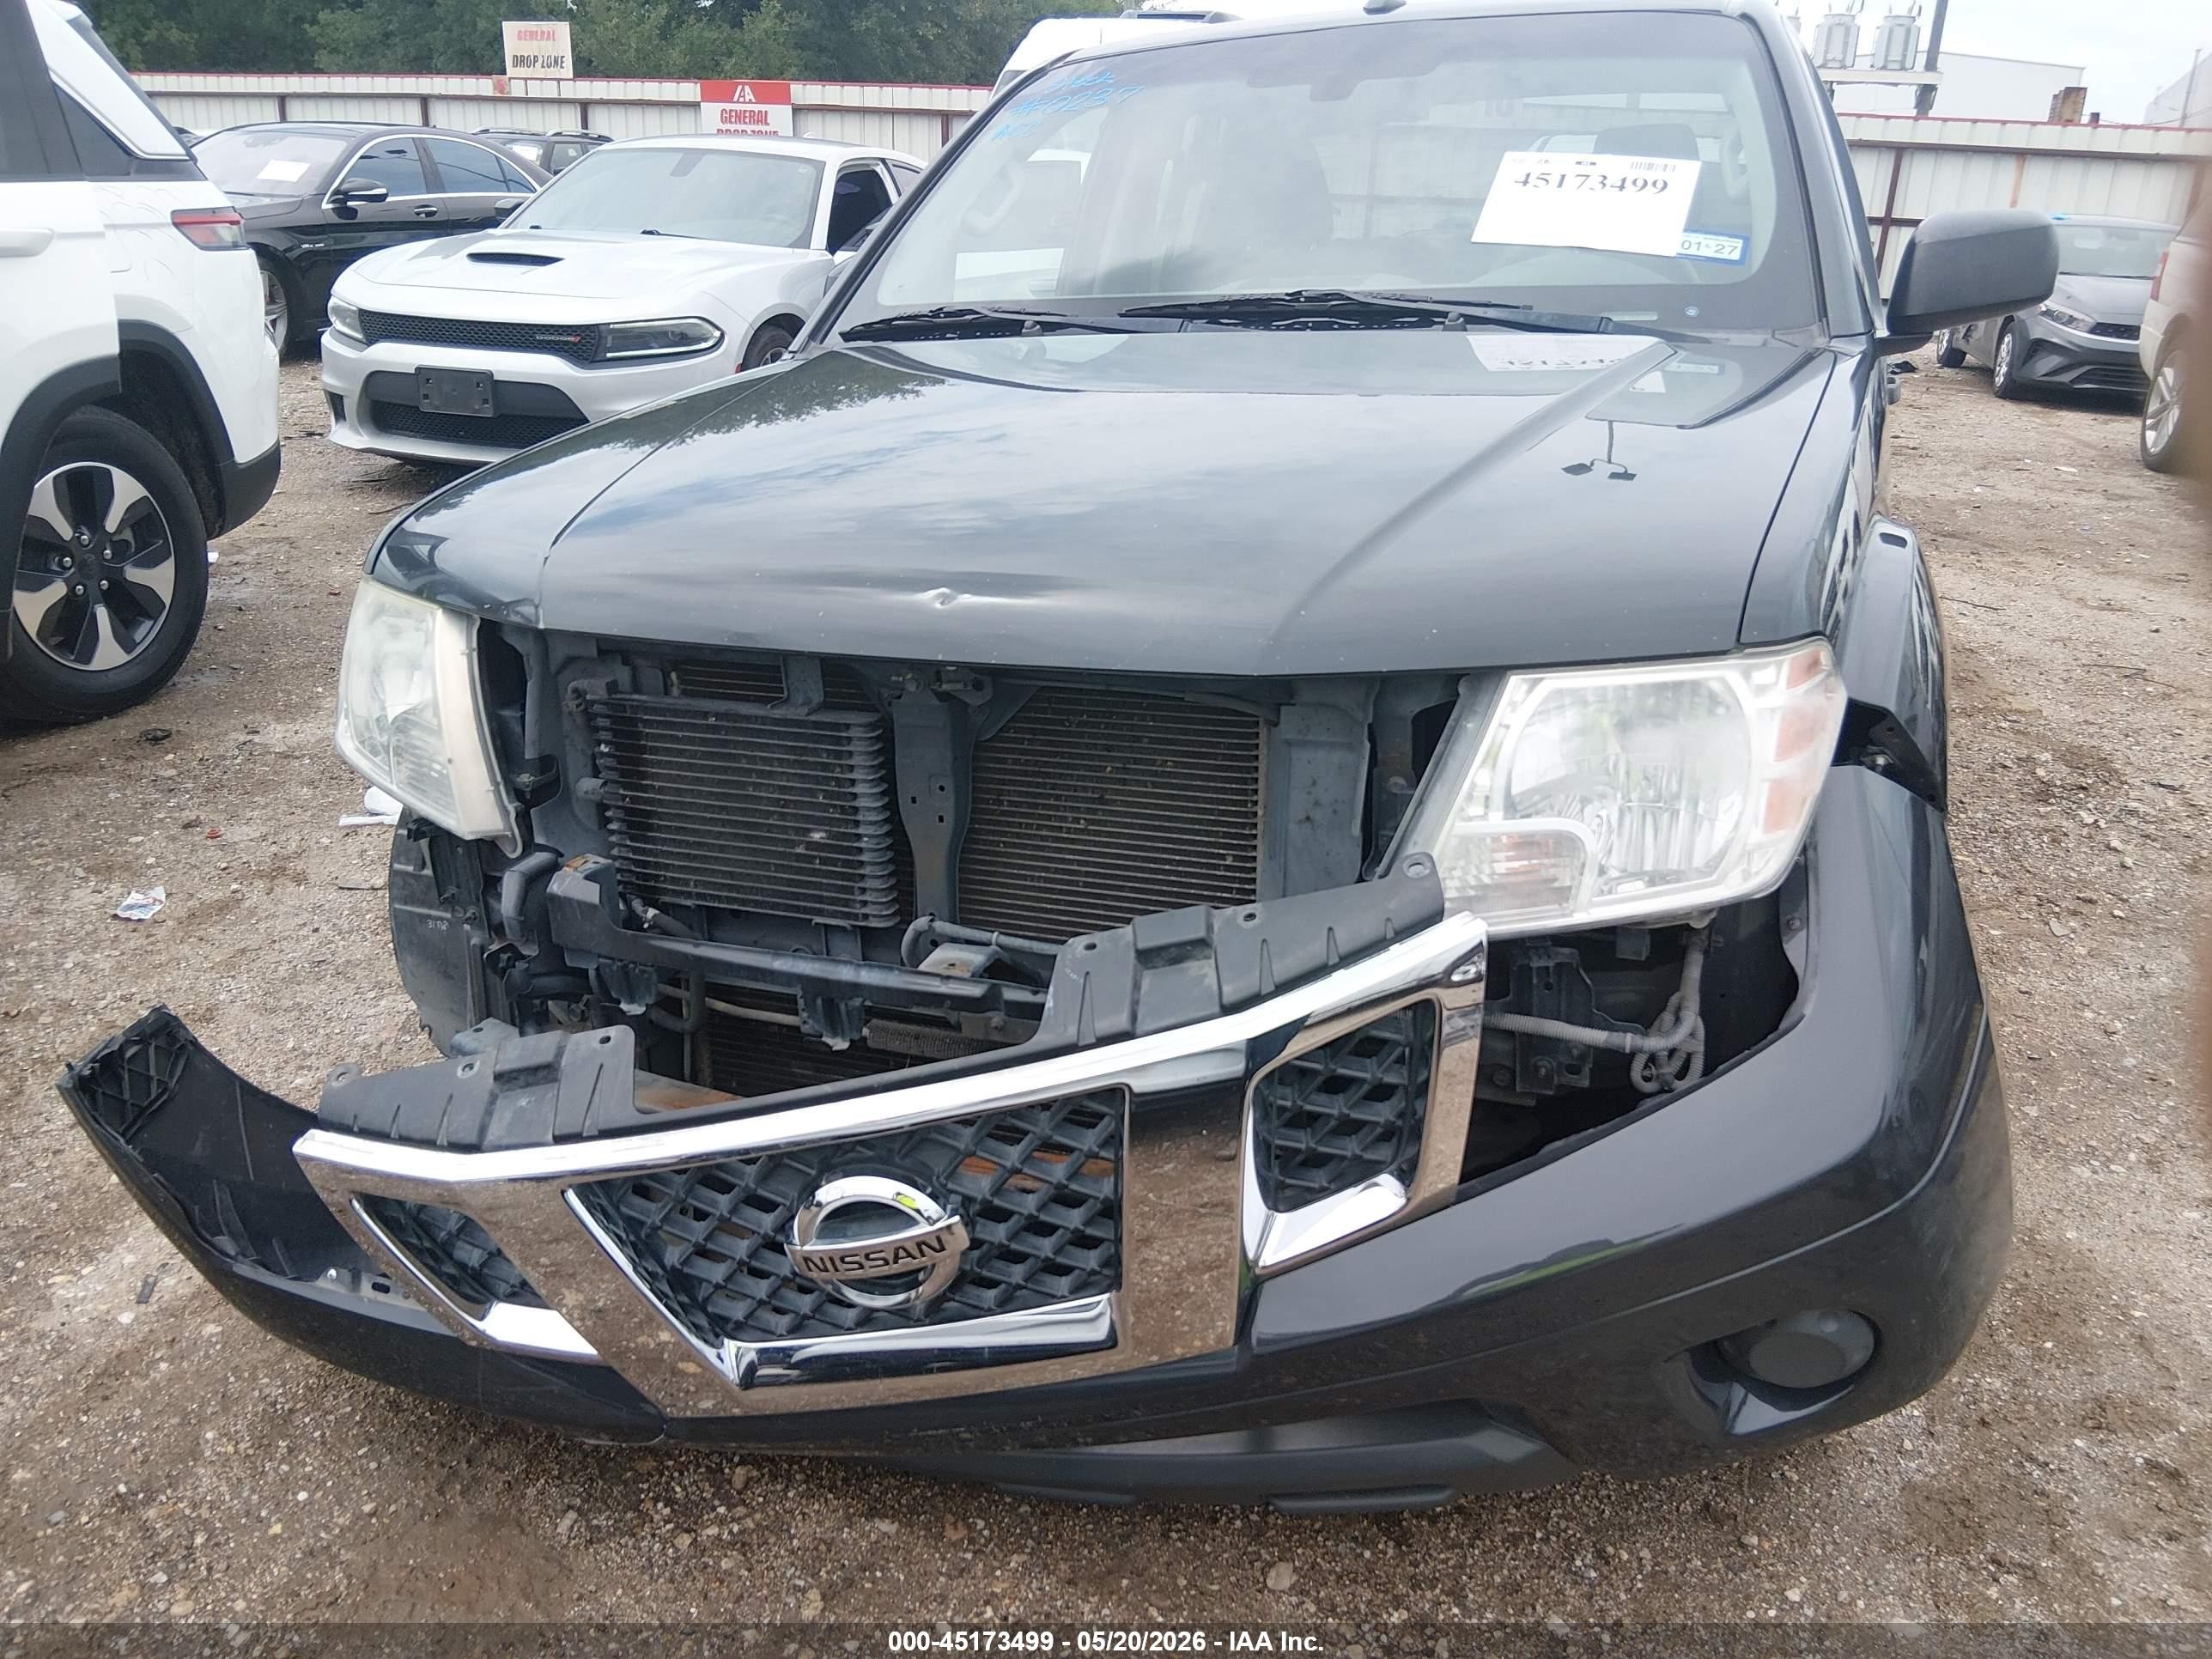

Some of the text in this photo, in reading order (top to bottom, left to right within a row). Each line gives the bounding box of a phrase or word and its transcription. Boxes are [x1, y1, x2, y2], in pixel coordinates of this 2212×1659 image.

[517, 30, 556, 41] GENERAL
[512, 54, 566, 69] DROP ZONE
[720, 108, 770, 126] GENERAL
[1514, 171, 1668, 194] 45173499
[1713, 243, 1739, 255] 27
[802, 1234, 947, 1273] NISSAN
